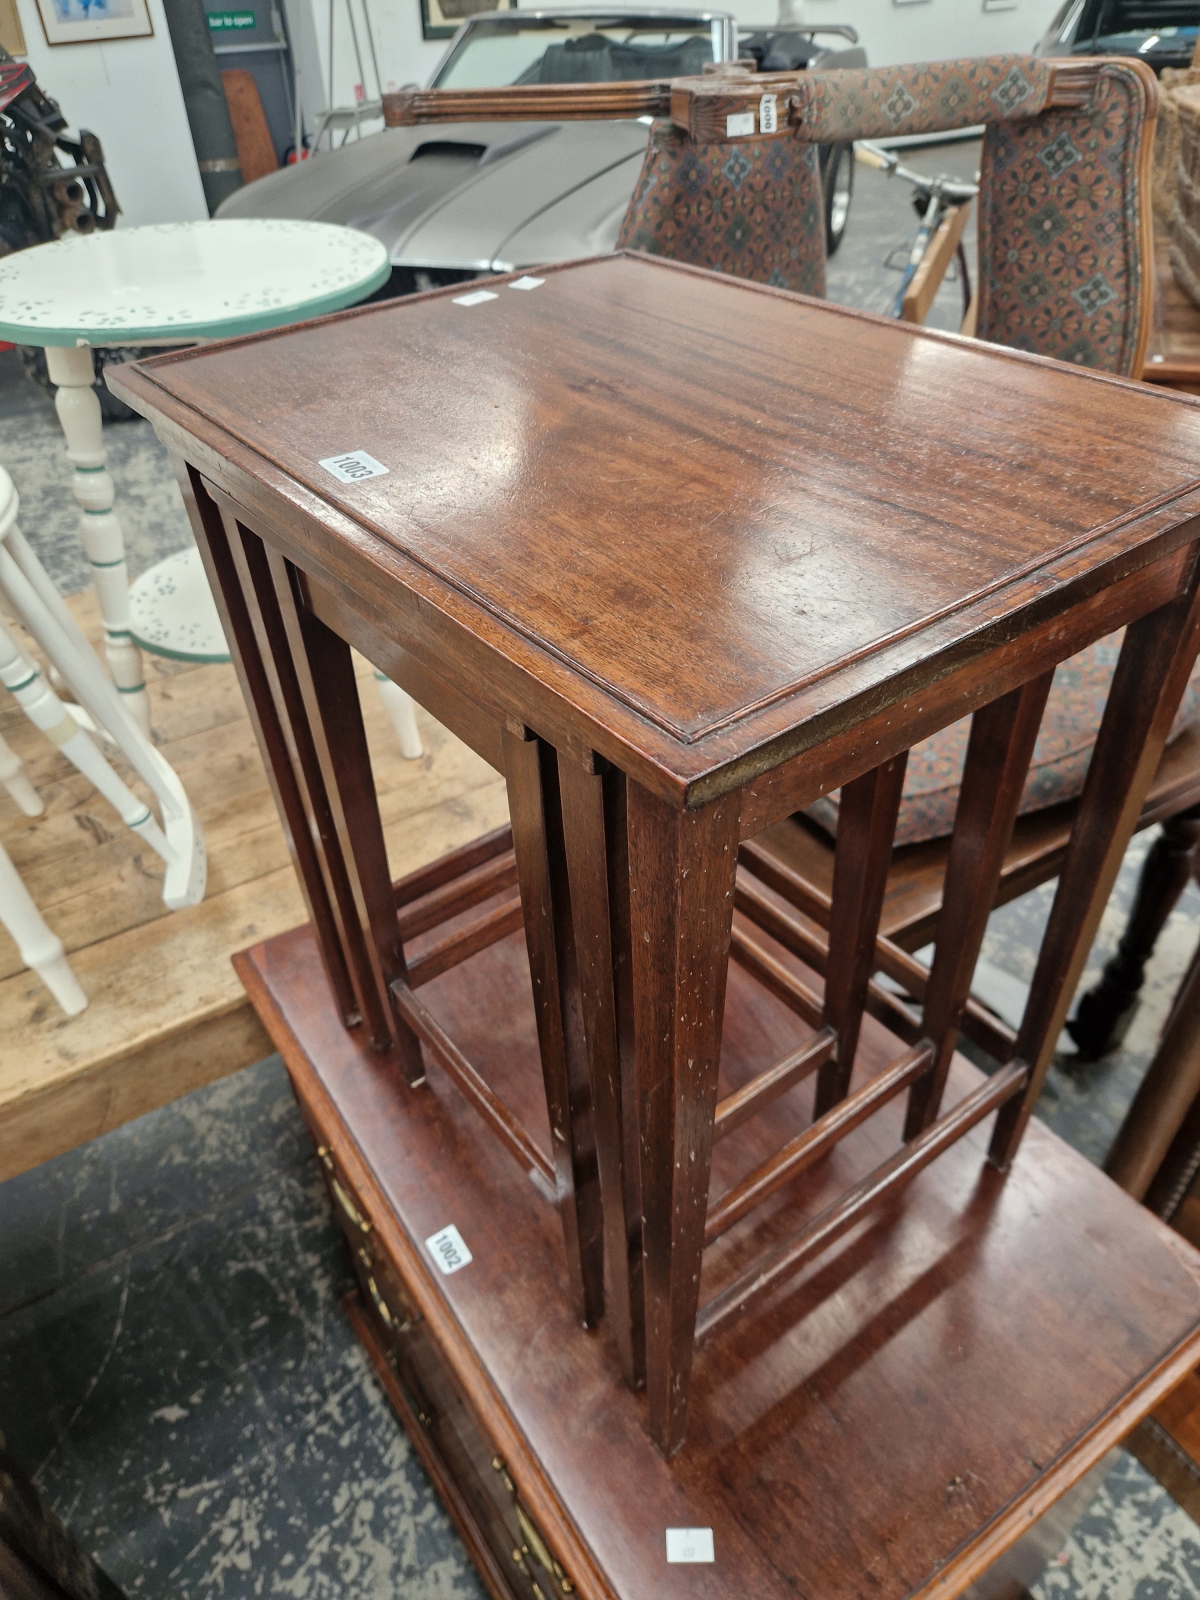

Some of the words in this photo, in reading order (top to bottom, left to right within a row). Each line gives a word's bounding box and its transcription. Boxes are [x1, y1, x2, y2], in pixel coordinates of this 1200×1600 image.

[209, 17, 223, 27] bar
[223, 16, 233, 26] to
[233, 16, 253, 28] open
[333, 456, 373, 479] 1003
[435, 1234, 462, 1268] 1002
